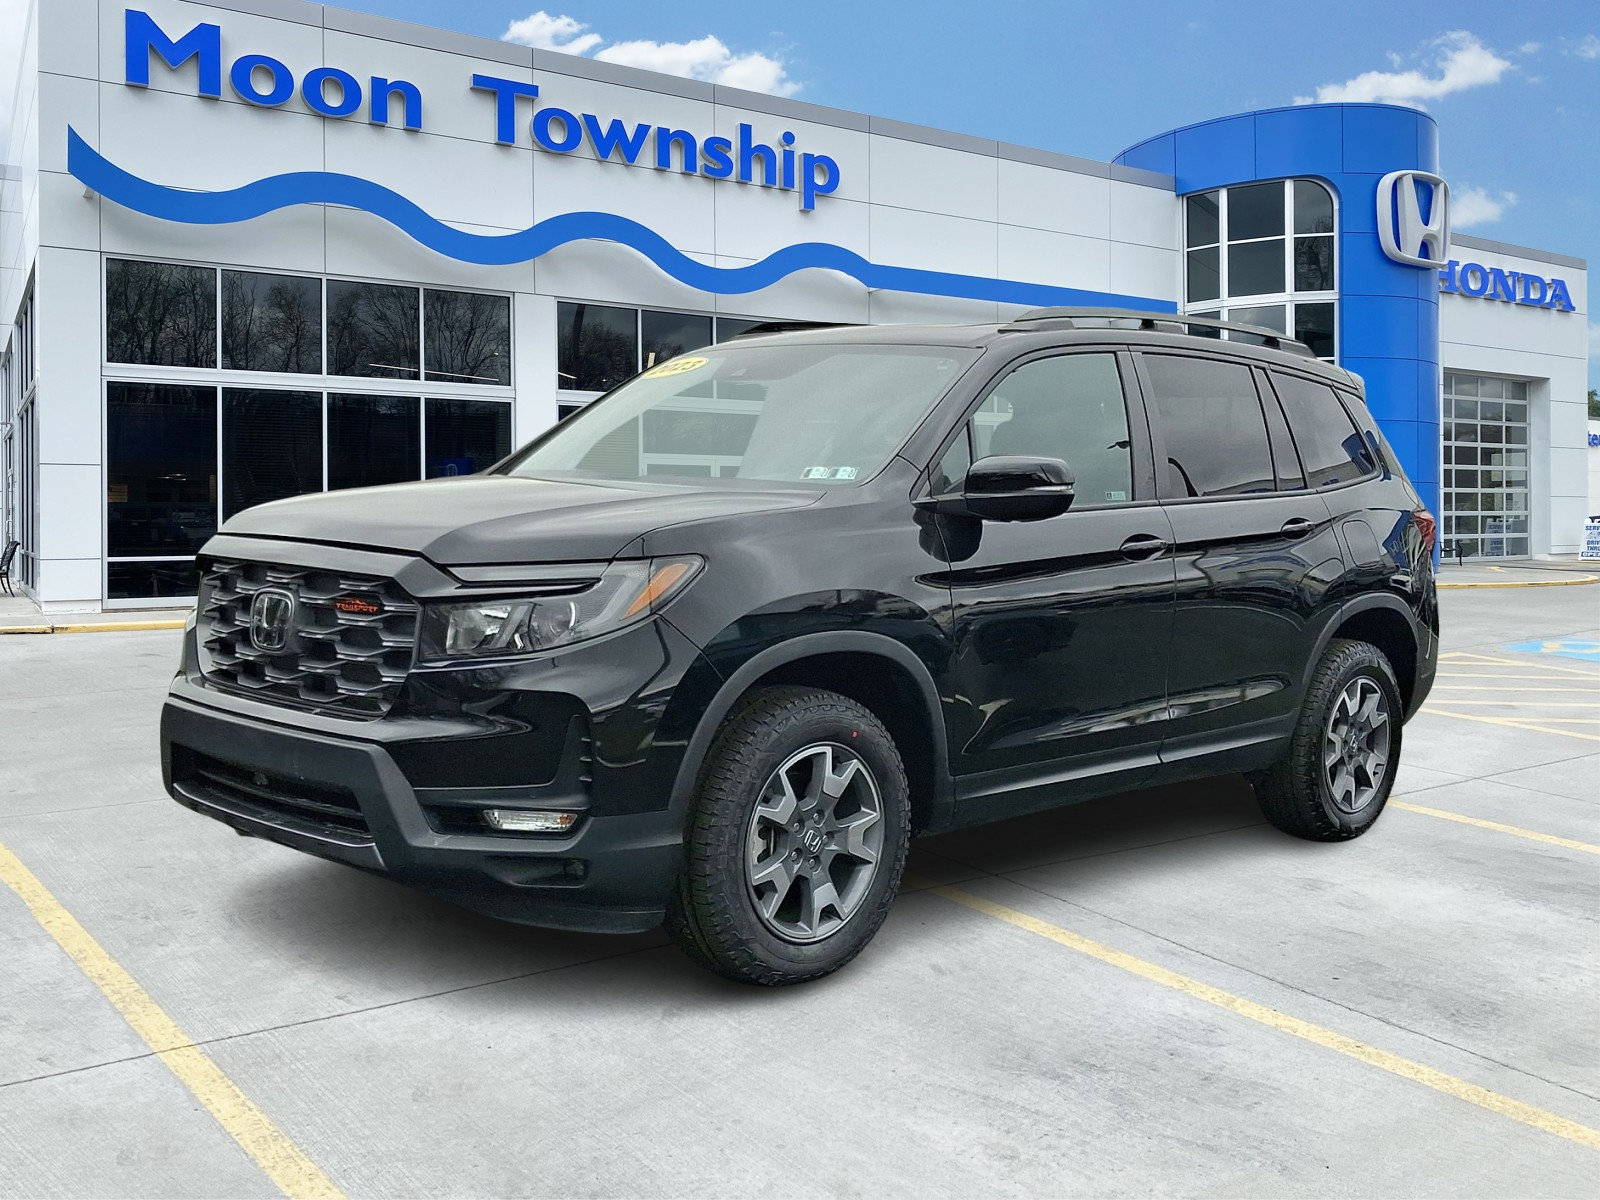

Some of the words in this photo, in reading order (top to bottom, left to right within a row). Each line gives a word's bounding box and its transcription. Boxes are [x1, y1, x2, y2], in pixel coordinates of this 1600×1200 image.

[125, 9, 422, 130] Moon
[471, 74, 841, 211] Township
[1439, 260, 1576, 311] HONDA
